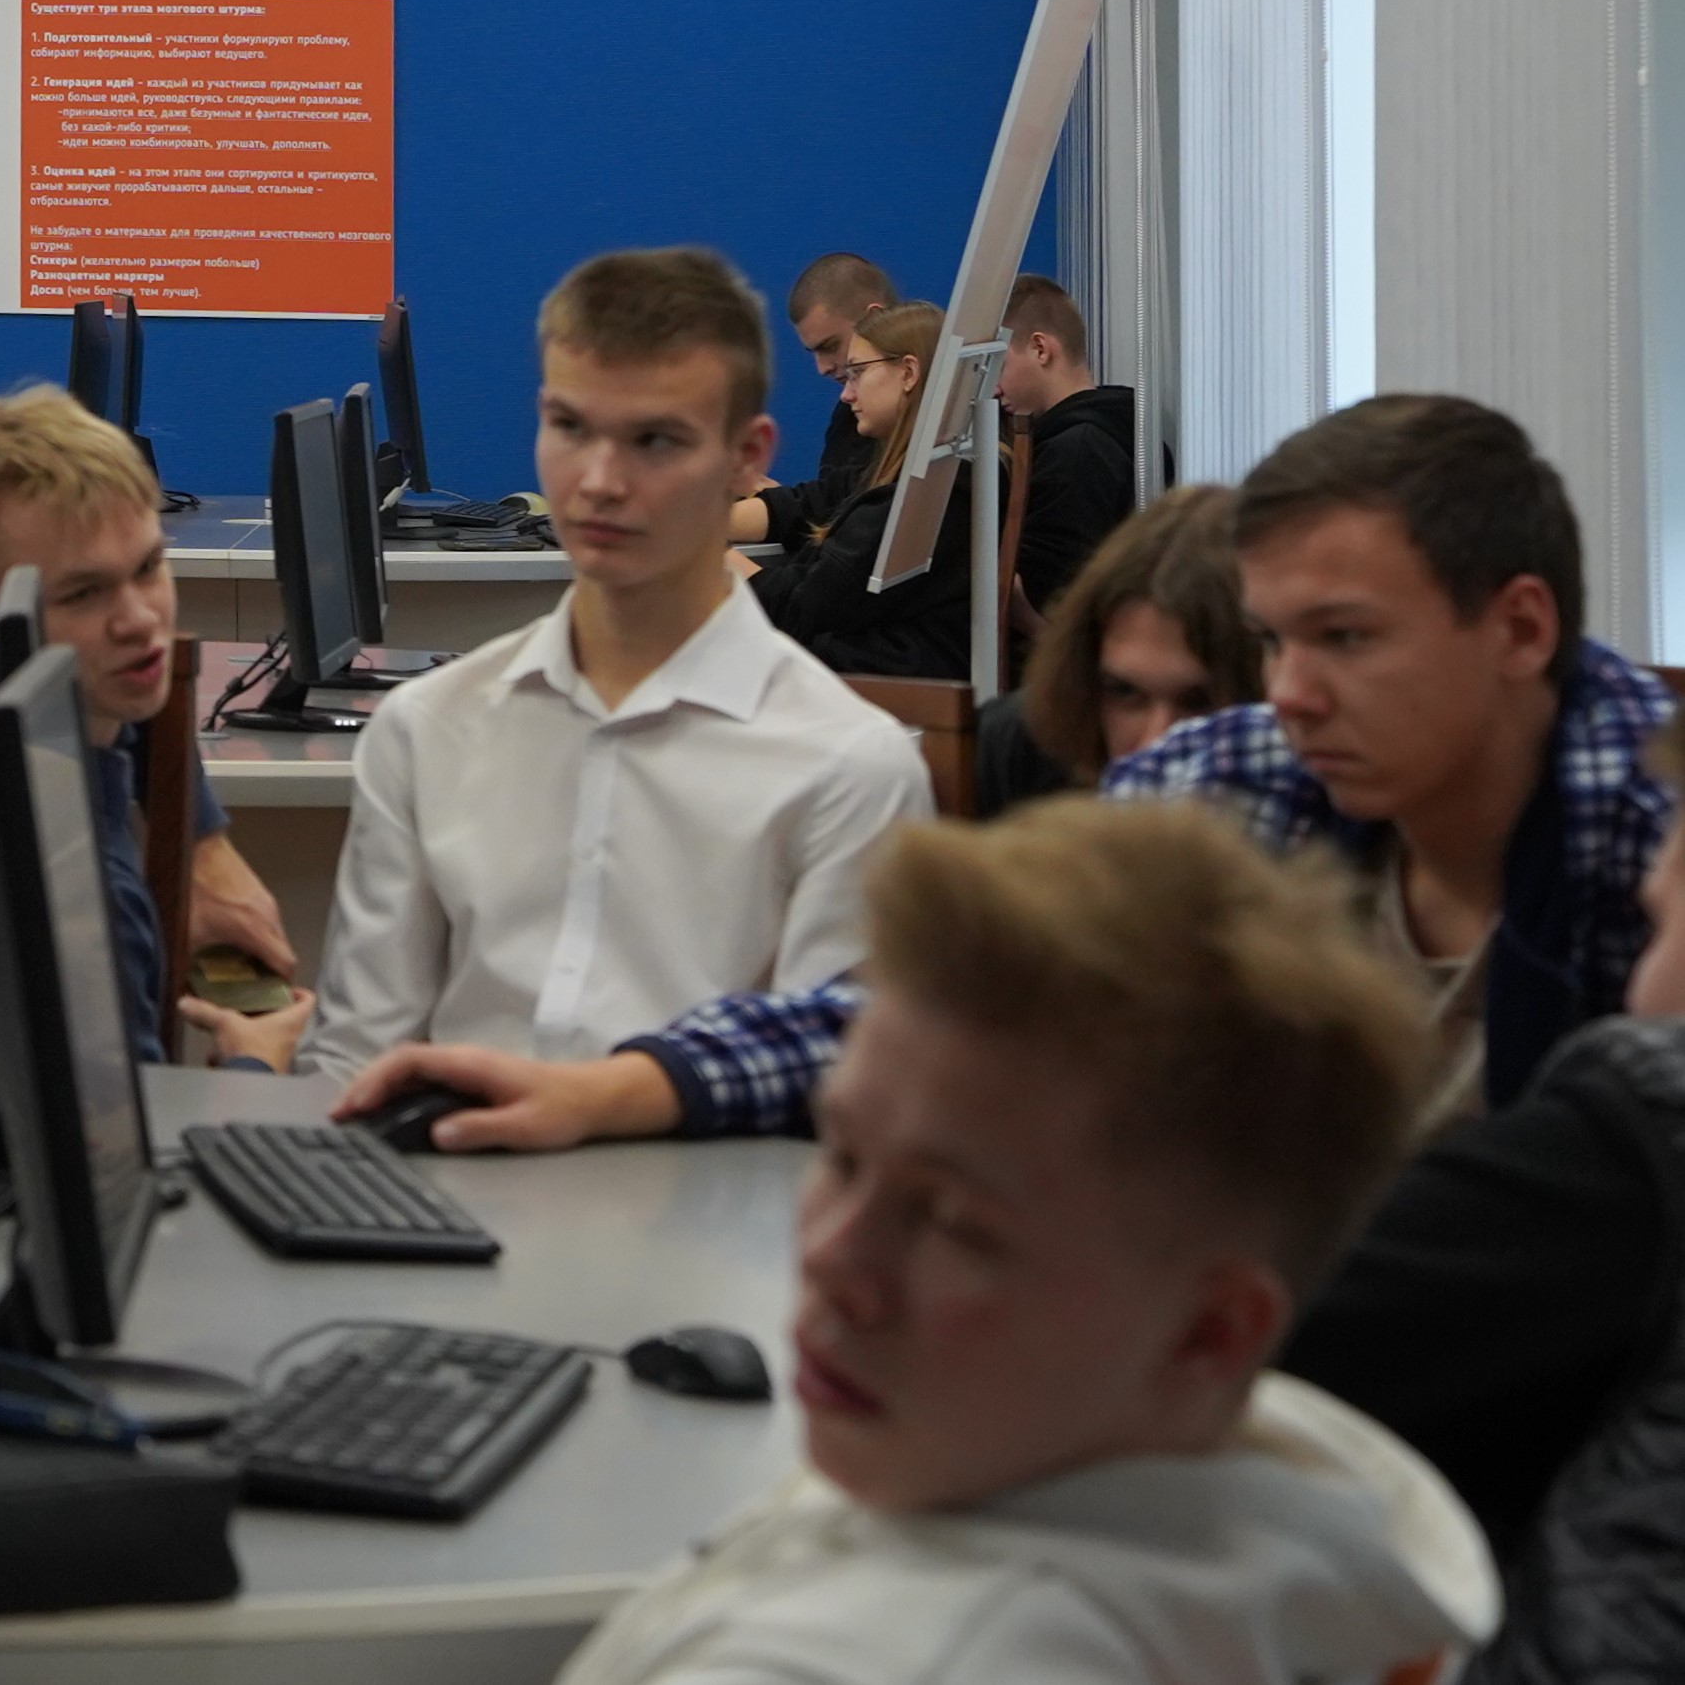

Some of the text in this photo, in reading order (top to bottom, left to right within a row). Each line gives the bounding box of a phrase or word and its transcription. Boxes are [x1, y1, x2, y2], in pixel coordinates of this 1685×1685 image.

[29, 1, 95, 15] Существует
[96, 4, 118, 15] три
[120, 4, 154, 13] этапа
[155, 4, 216, 14] мозгового
[29, 268, 165, 283] Разноцветные маркеры
